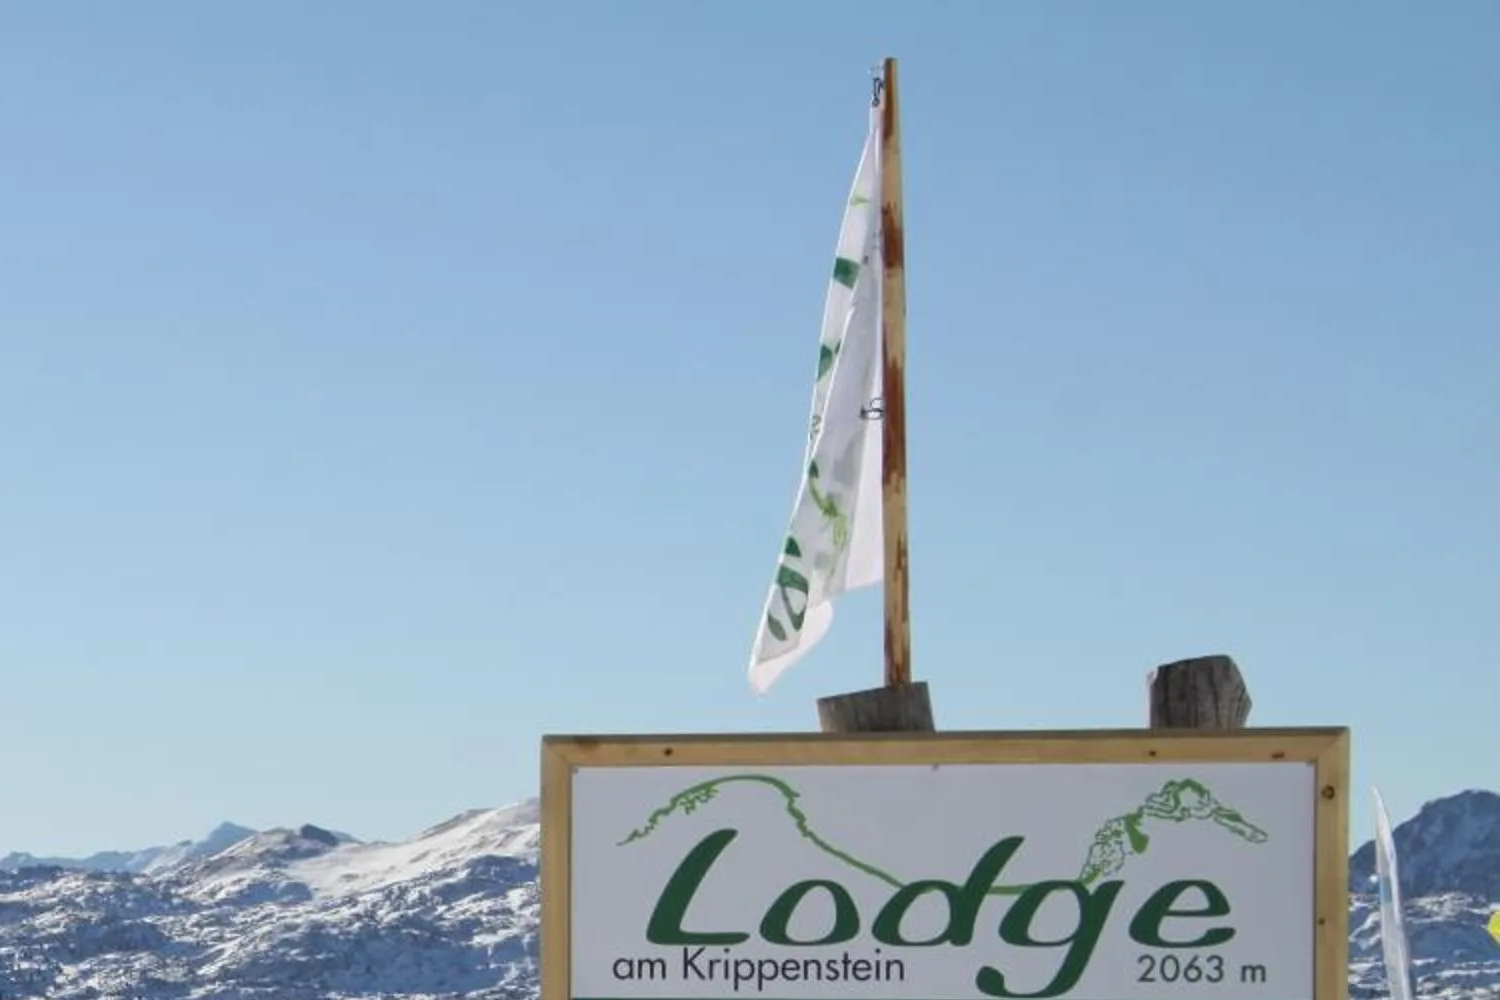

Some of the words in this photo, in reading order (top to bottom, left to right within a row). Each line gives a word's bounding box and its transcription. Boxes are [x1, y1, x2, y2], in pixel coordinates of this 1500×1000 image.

[645, 828, 1237, 999] Lodge
[612, 957, 668, 981] am
[682, 946, 906, 992] Krippenstein
[1136, 954, 1225, 984] 2063
[1240, 963, 1268, 983] m
